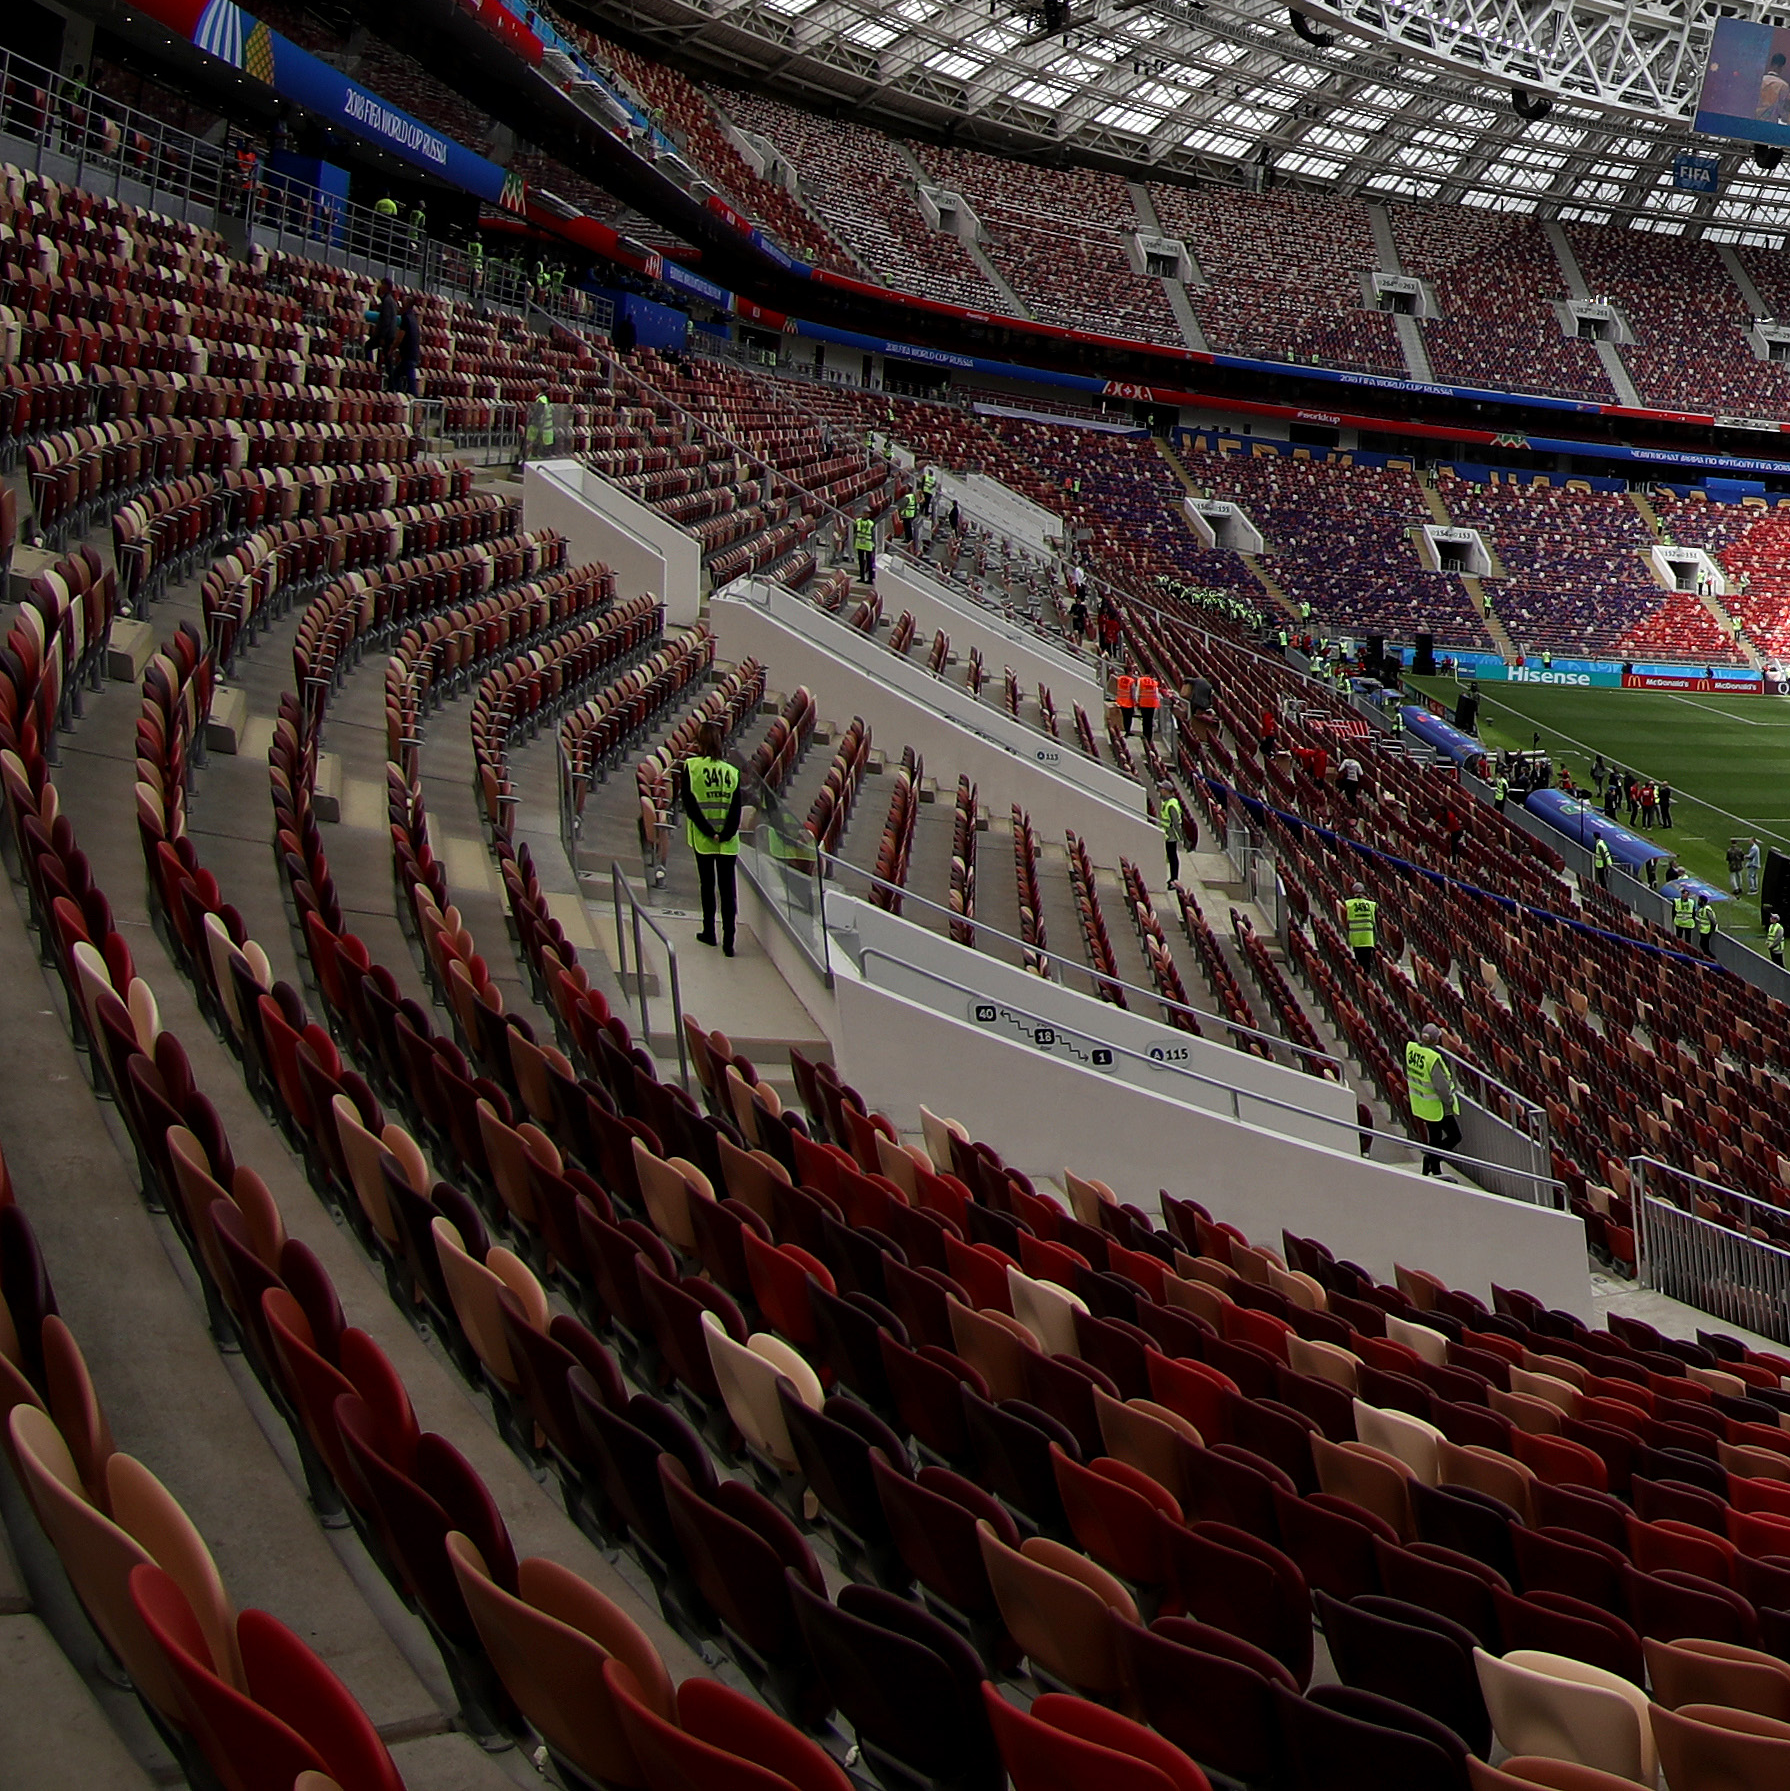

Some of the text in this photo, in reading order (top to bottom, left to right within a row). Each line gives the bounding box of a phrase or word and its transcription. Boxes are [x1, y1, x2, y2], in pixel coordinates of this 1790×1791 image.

[1680, 165, 1711, 183] FIFA
[1376, 378, 1405, 389] WORLD
[1406, 382, 1423, 392] CUP
[1424, 384, 1454, 396] RUSSIA
[1297, 411, 1341, 425] #worldcup
[1705, 455, 1717, 466] ПО
[1507, 665, 1591, 686] Hisense
[1646, 678, 1757, 691] McDonald's McDonald's
[703, 767, 732, 788] 3414
[978, 1008, 994, 1019] 40
[1037, 1032, 1051, 1042] 18
[1165, 1047, 1188, 1060] 115
